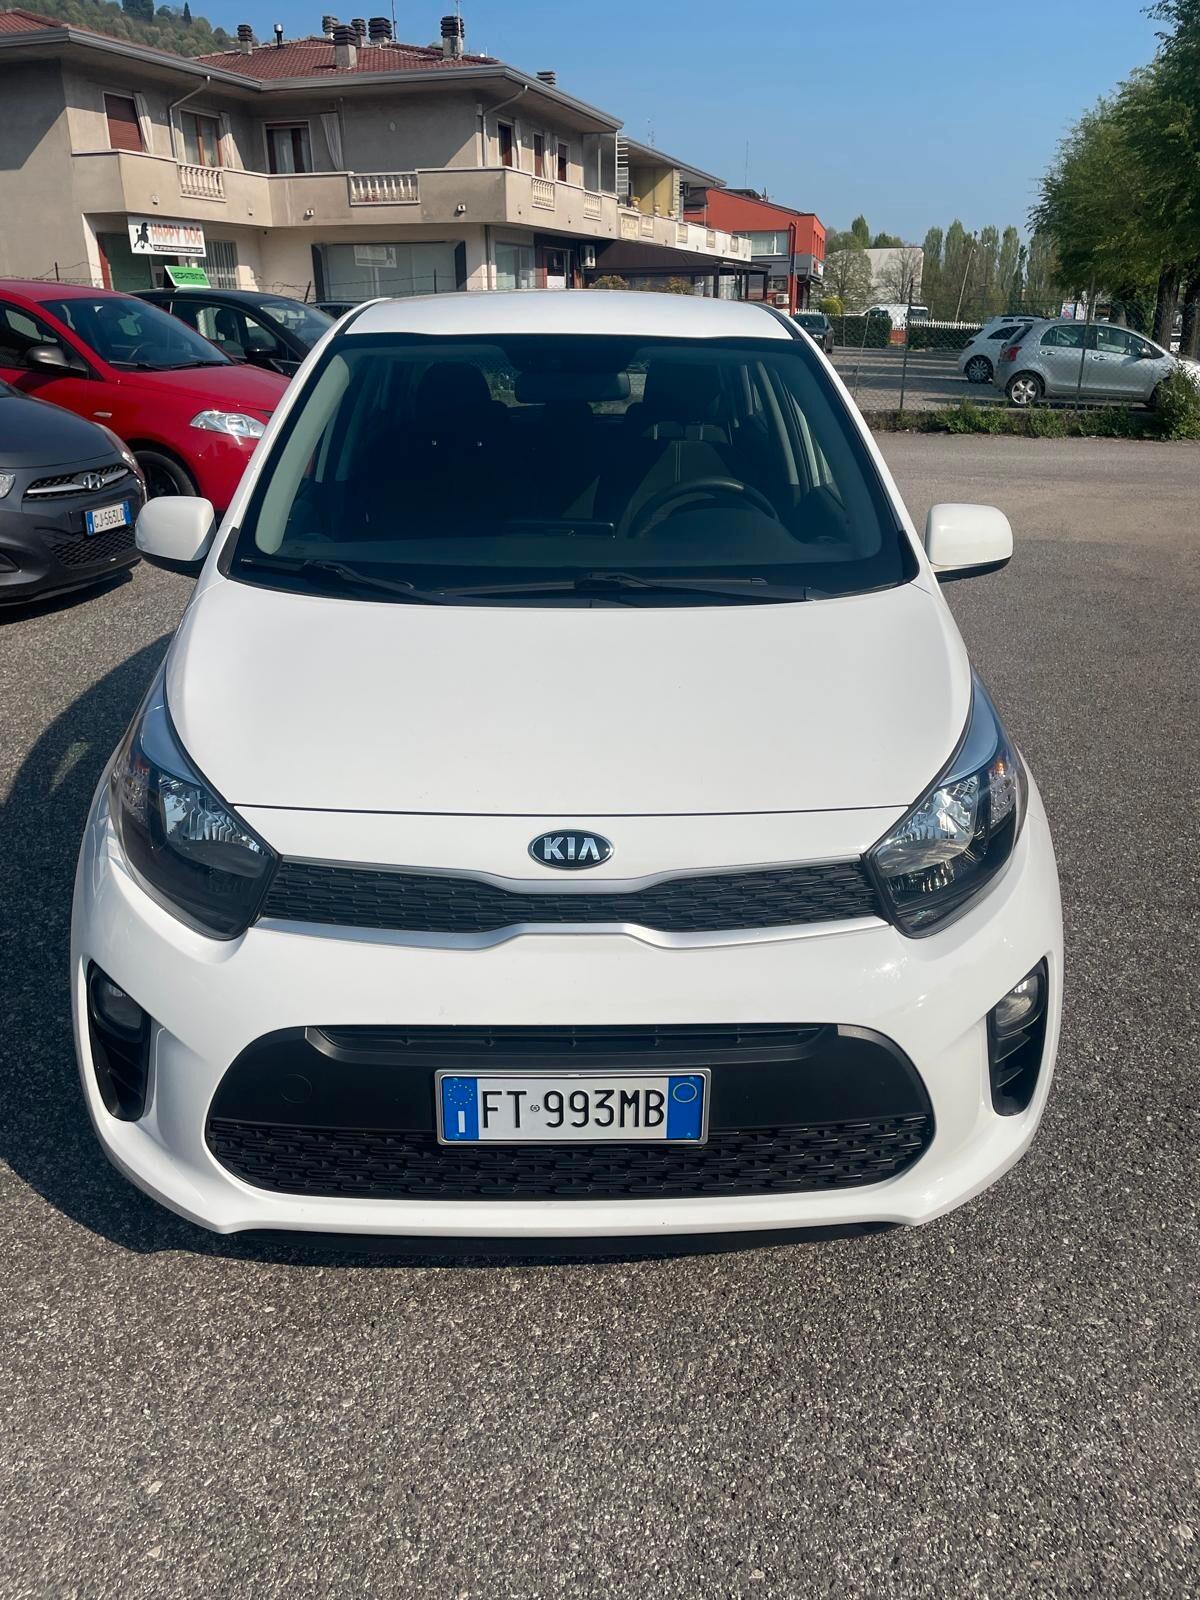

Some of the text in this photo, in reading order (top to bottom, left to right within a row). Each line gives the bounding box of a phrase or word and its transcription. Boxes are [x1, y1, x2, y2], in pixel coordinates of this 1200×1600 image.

[150, 223, 202, 245] HAPPY DOG
[543, 836, 601, 860] KIA
[481, 1089, 665, 1129] FT 993MB
